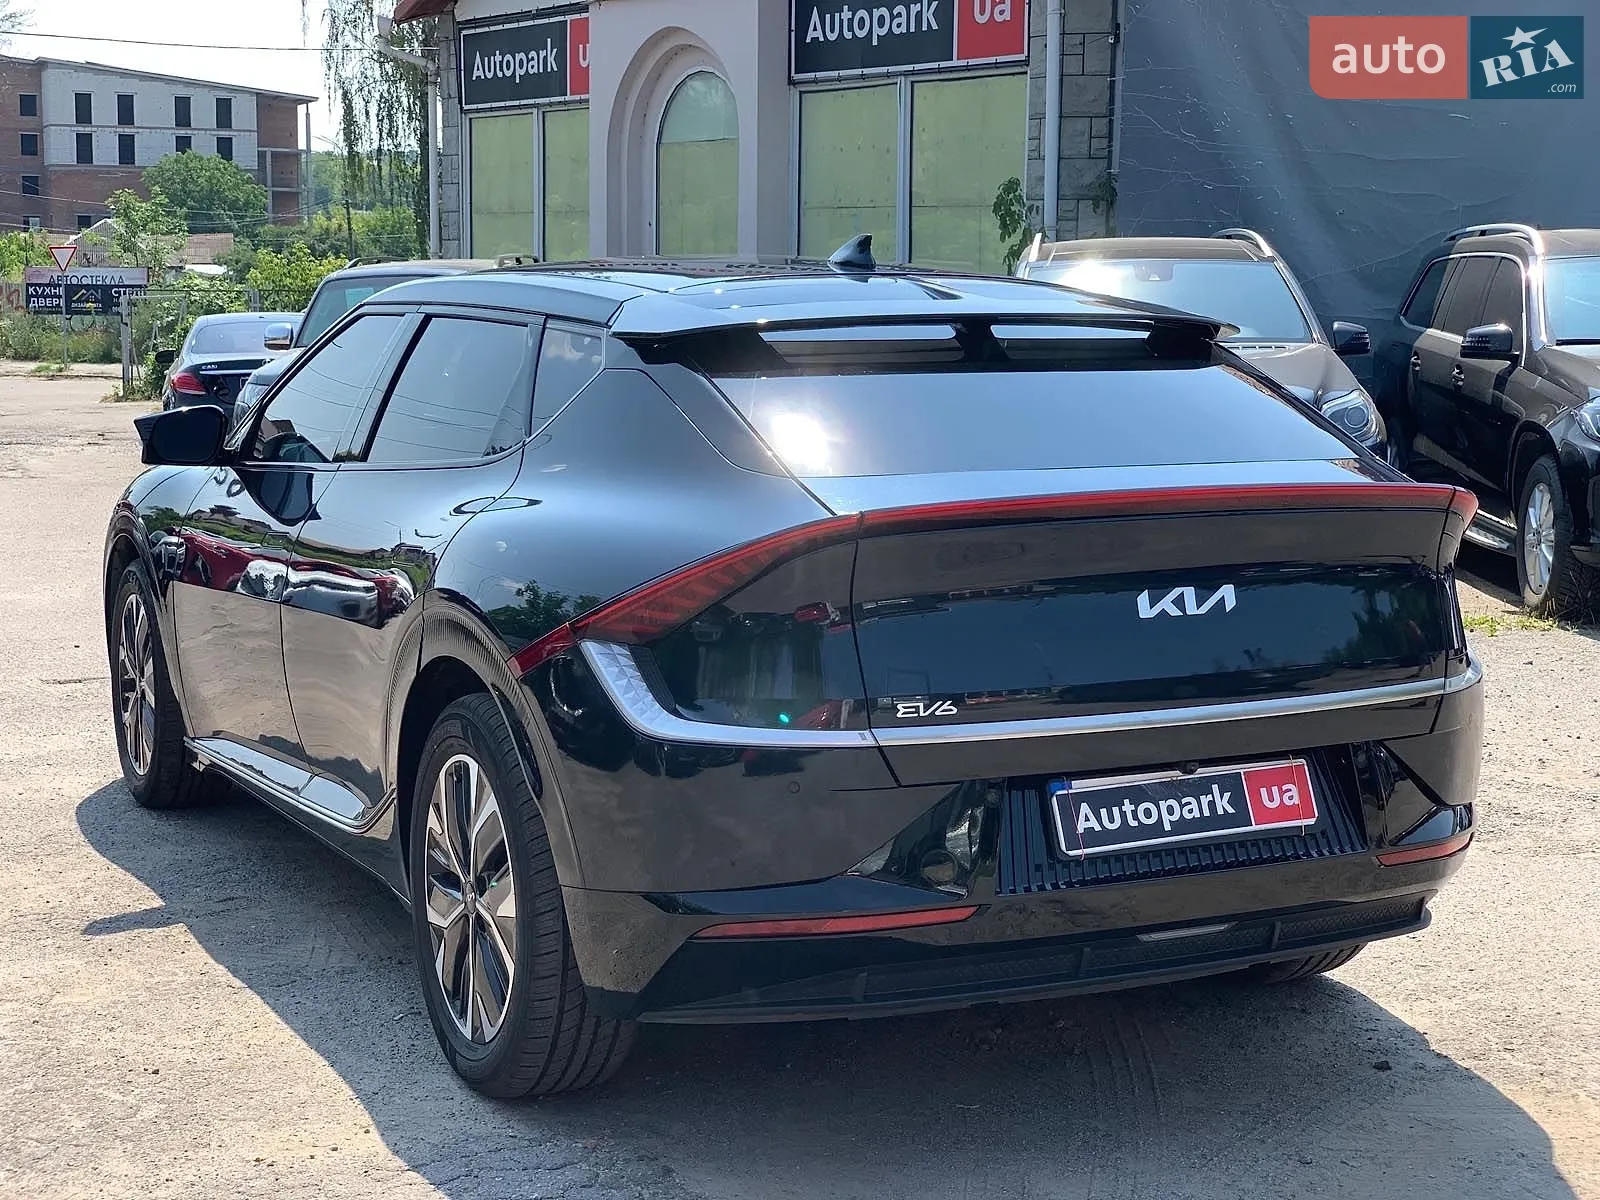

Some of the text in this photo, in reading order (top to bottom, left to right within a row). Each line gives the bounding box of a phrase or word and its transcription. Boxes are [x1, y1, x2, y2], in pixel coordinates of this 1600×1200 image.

[806, 0, 939, 46] Autopark
[472, 38, 558, 83] Autopark
[1136, 584, 1237, 619] KIA
[896, 700, 958, 718] EV6
[1076, 782, 1300, 833] Autopark ua
